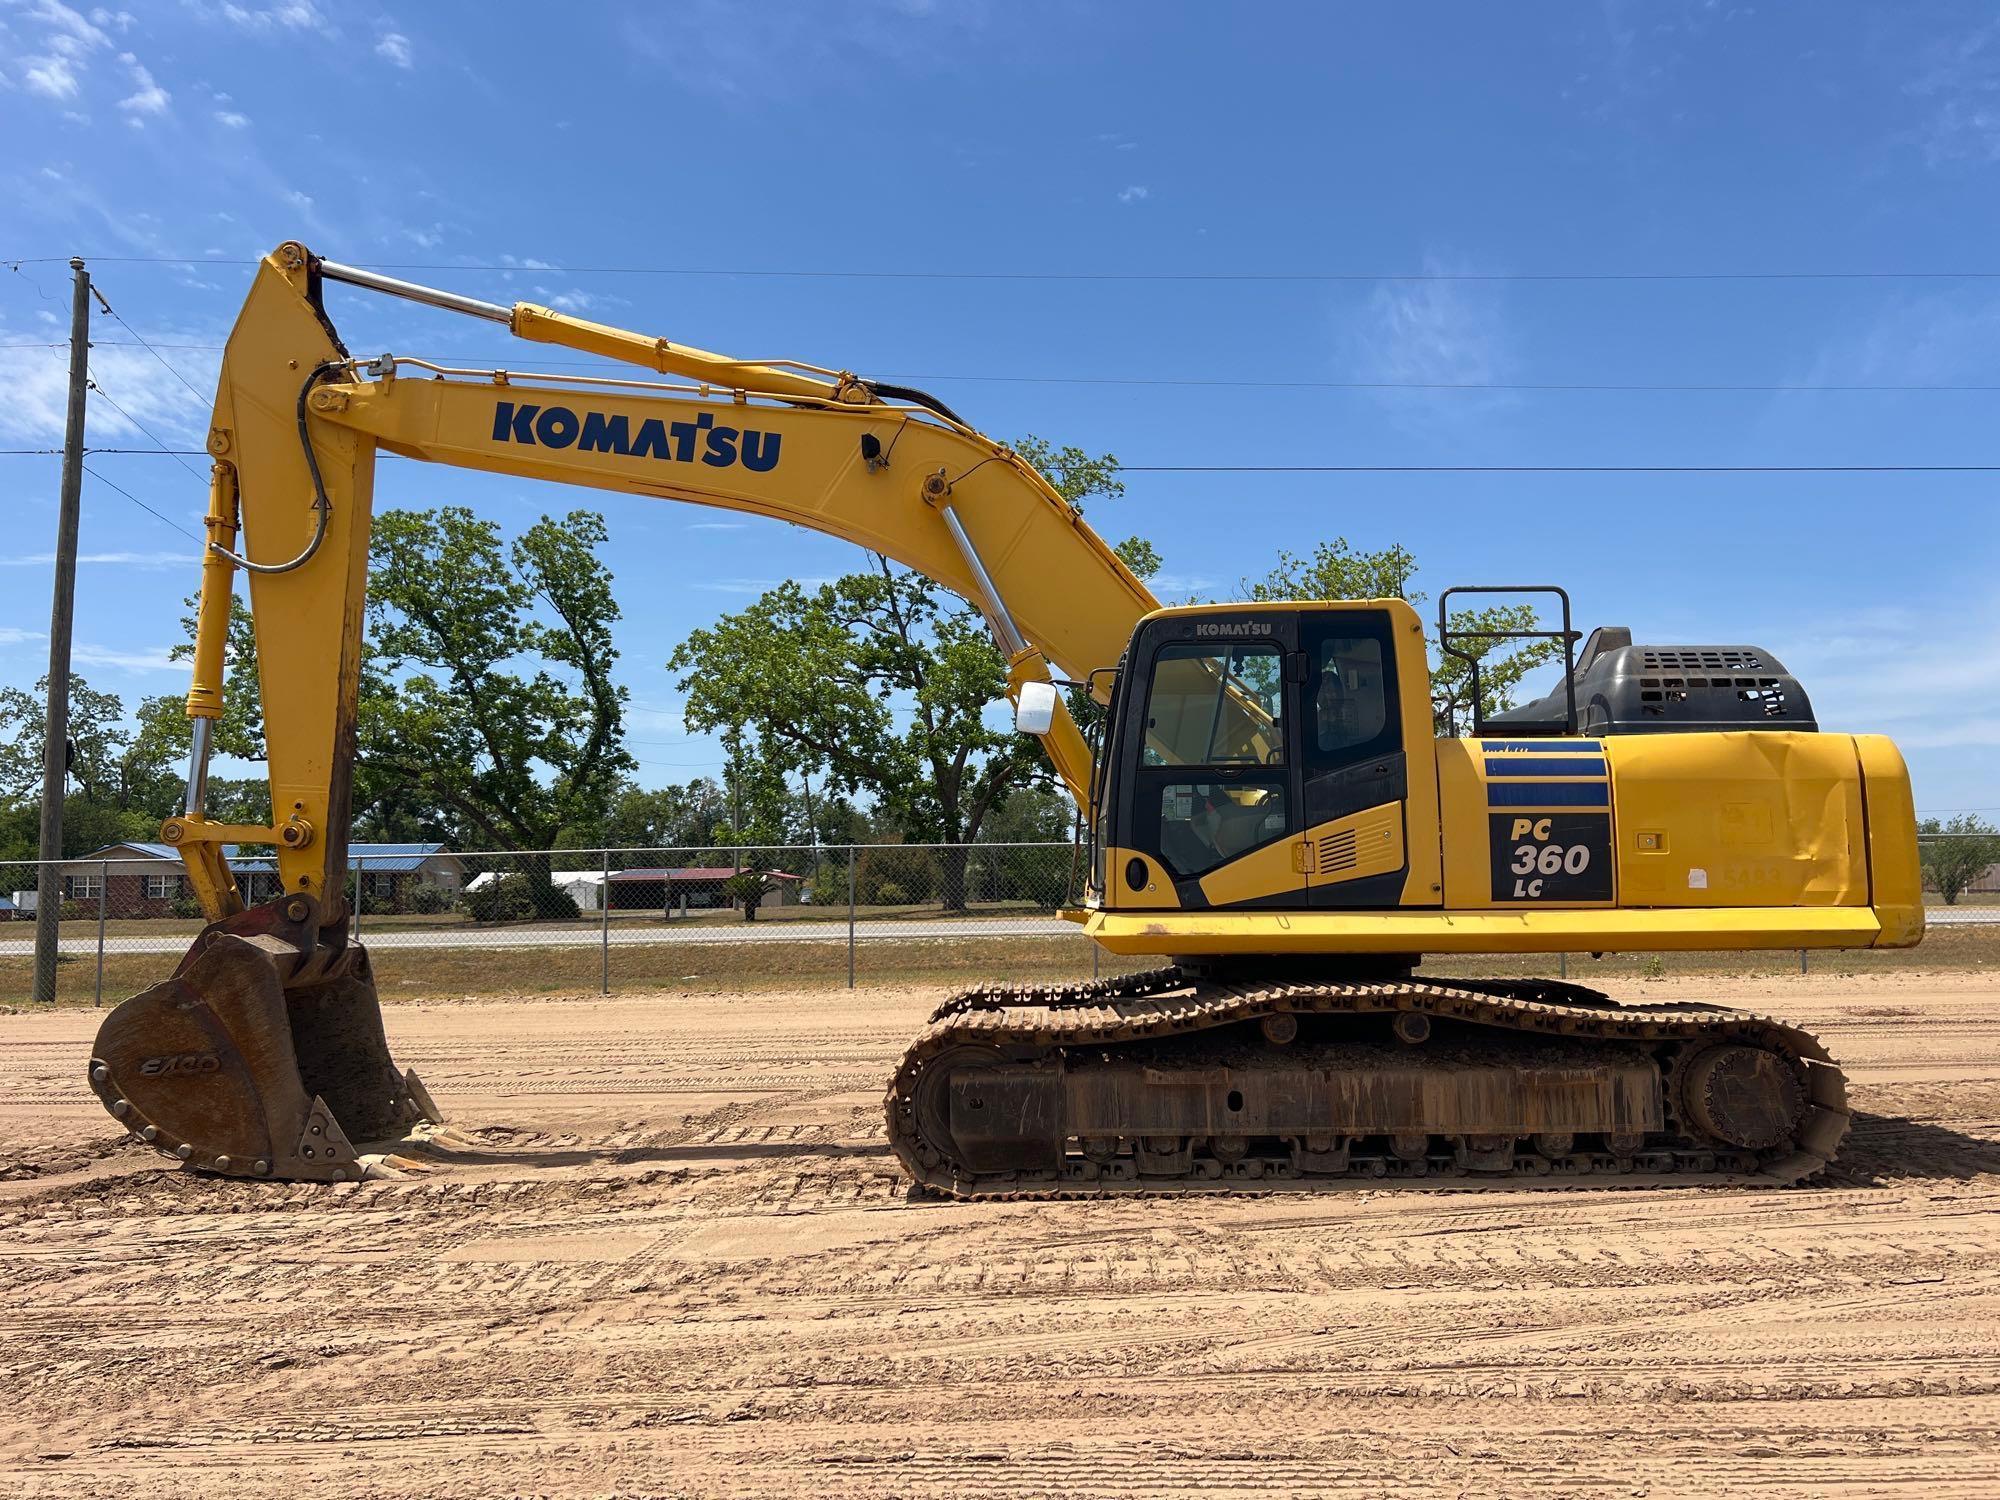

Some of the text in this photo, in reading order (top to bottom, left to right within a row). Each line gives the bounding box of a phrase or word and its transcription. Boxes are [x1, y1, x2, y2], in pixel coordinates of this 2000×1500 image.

[492, 401, 782, 472] KOMATSU
[1196, 620, 1272, 636] KOMATSU
[1511, 818, 1552, 841] PC
[1511, 844, 1590, 875] 360
[1513, 878, 1543, 898] LC
